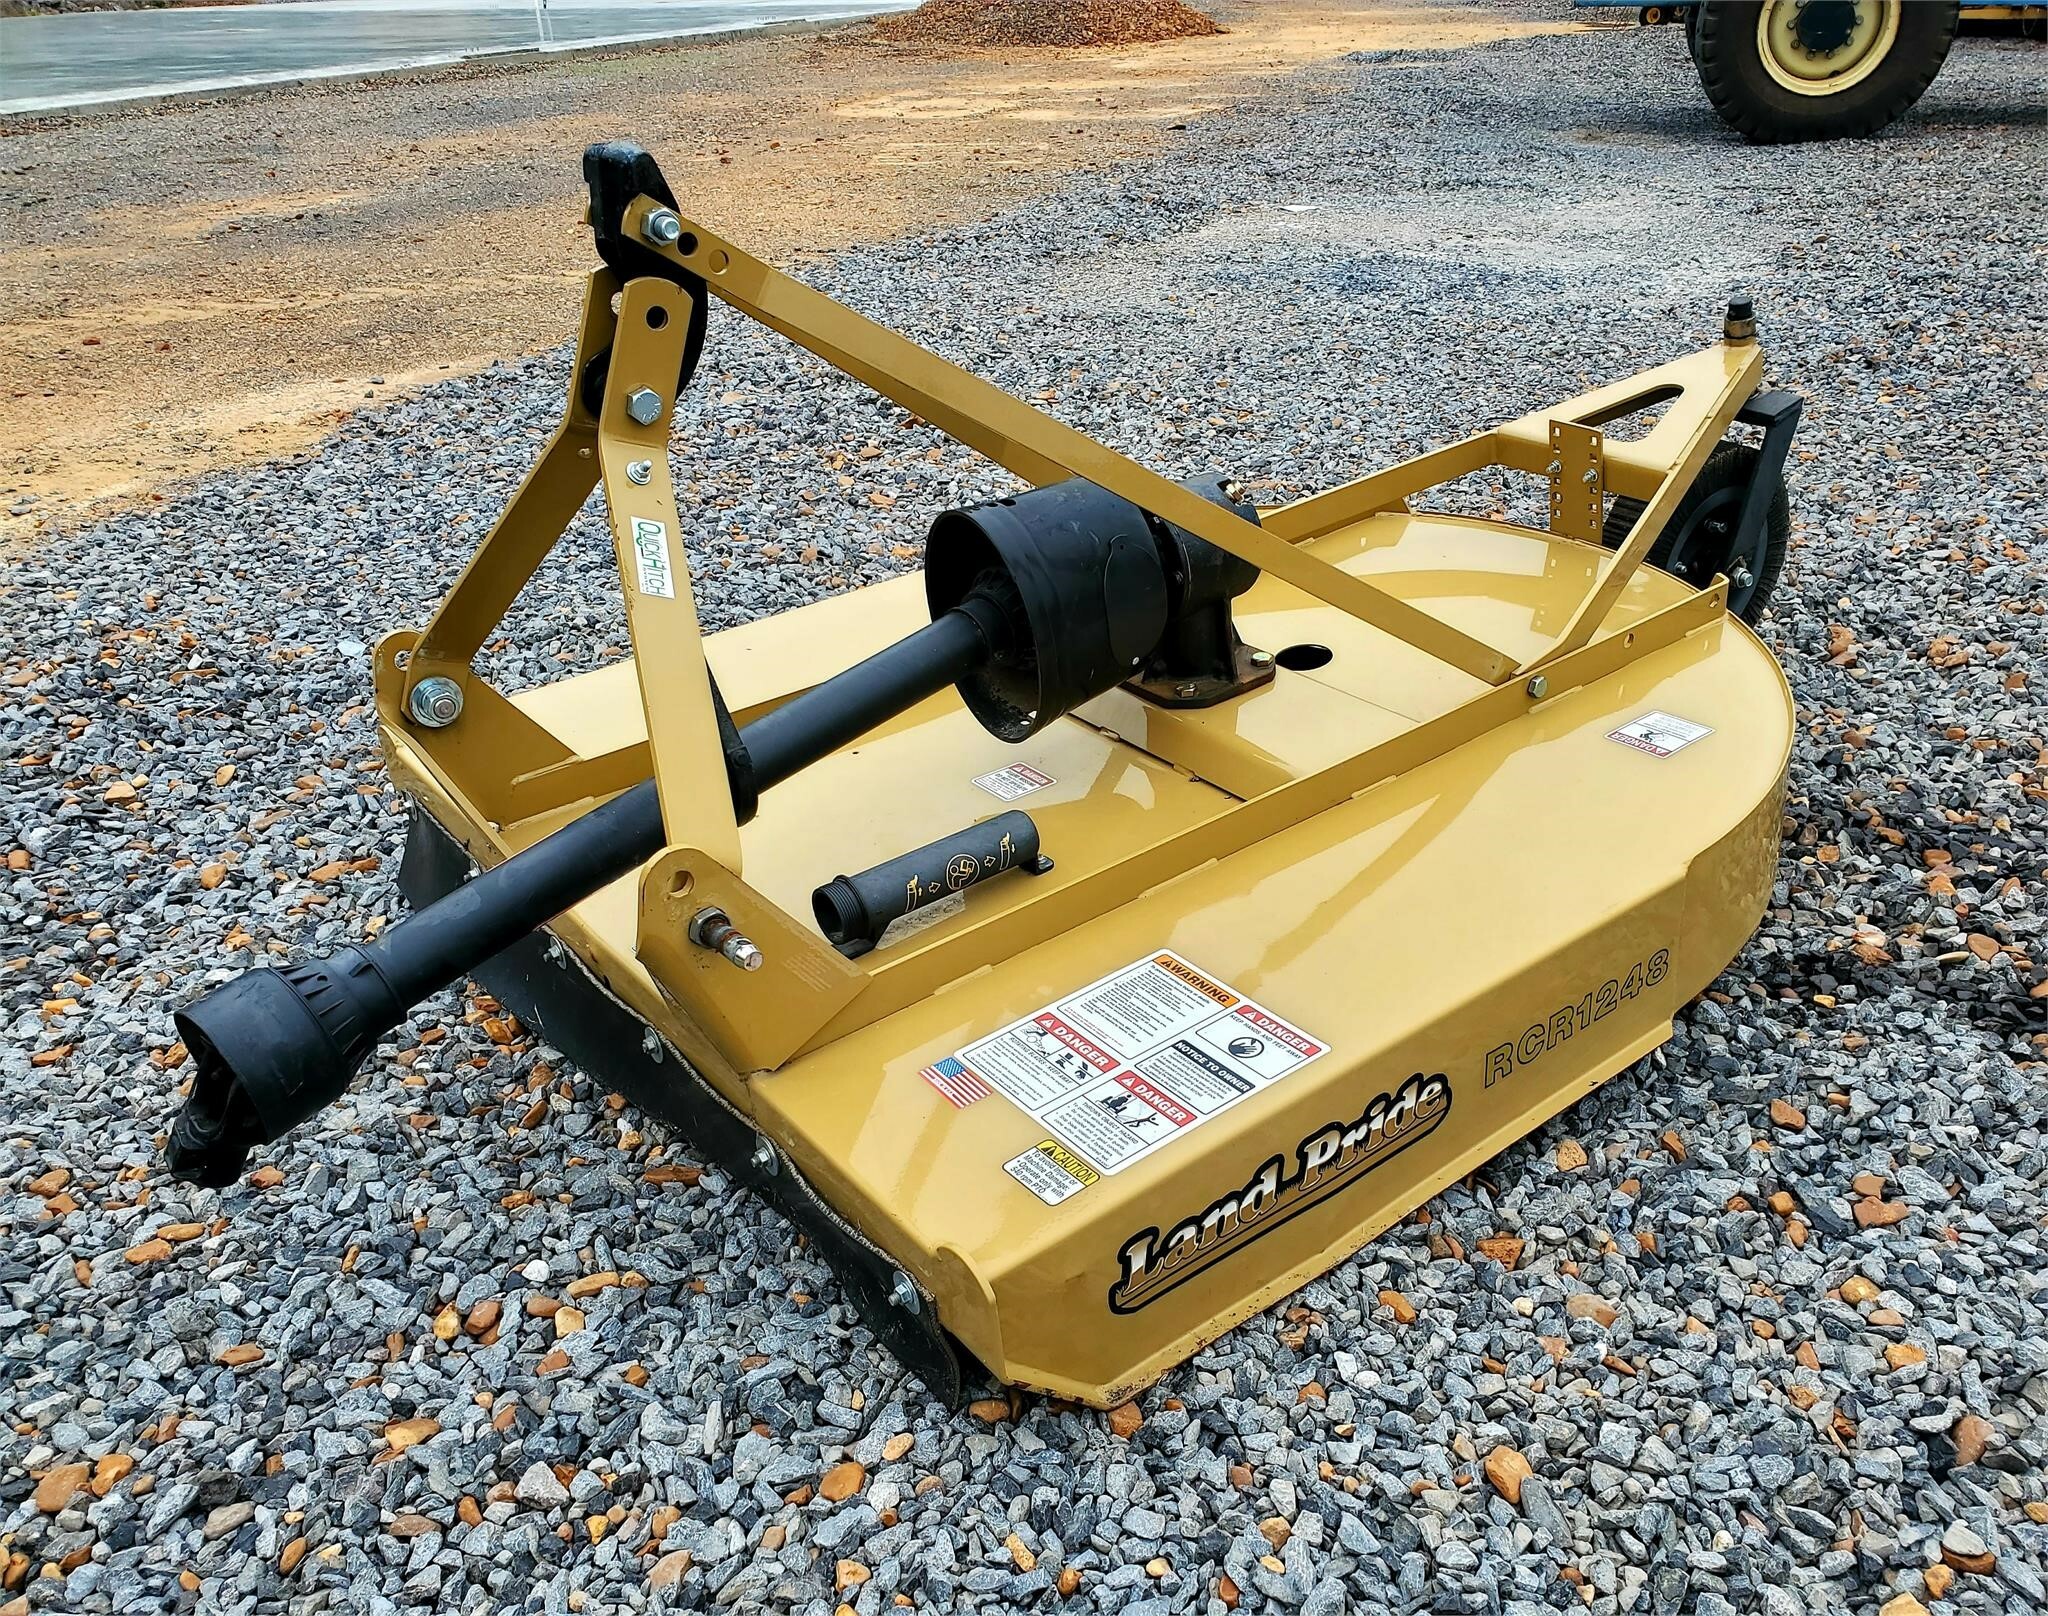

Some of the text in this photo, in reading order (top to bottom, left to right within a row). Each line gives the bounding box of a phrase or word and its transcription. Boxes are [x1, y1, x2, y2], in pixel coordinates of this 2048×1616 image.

[1609, 732, 1656, 750] DANGER
[1167, 963, 1232, 1003] WARNING
[1255, 1017, 1311, 1051] DANGER
[1484, 949, 1670, 1088] RCR1248
[1051, 1026, 1110, 1066] DANGER
[1174, 1042, 1250, 1091] NOTICE TO OWNER
[1132, 1083, 1188, 1121] DANGER
[1017, 1161, 1042, 1180] Operate
[1037, 1177, 1053, 1189] only
[1049, 1186, 1065, 1198] with
[1022, 1154, 1049, 1173] Machine
[1030, 1150, 1042, 1158] To
[1037, 1155, 1056, 1169] avoid
[1068, 1178, 1078, 1186] or
[1051, 1150, 1095, 1183] CAUTION
[1018, 1174, 1034, 1185] rpm
[1030, 1181, 1047, 1194] PTO
[1117, 1160, 1282, 1302] Land
[1297, 1074, 1450, 1194] Pride
